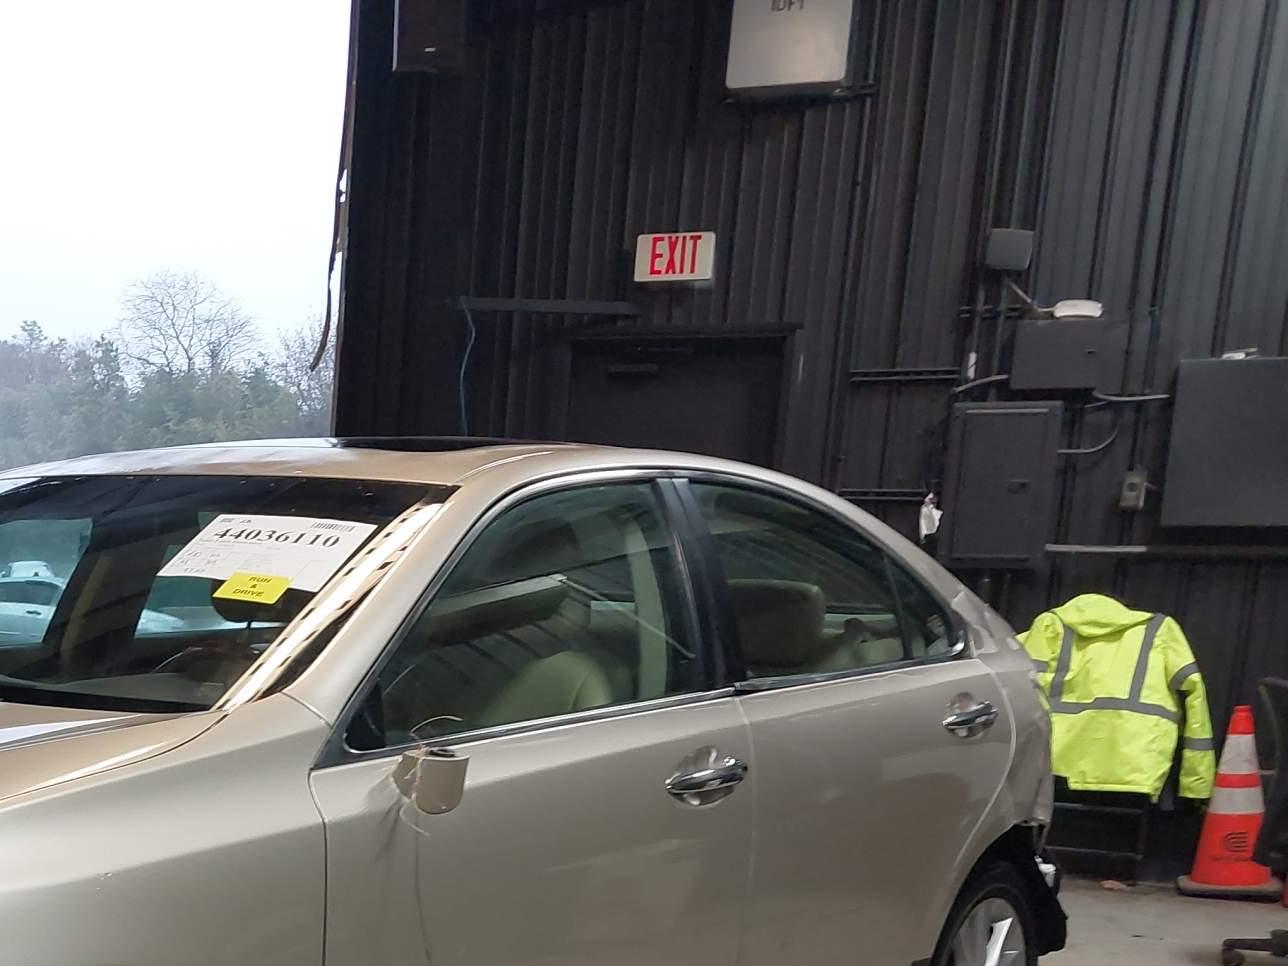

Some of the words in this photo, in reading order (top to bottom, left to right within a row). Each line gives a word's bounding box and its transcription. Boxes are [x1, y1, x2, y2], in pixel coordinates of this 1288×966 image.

[649, 234, 703, 276] EXIT
[213, 526, 341, 549] 44036110
[248, 576, 273, 584] RUN
[232, 588, 265, 597] DRIVE
